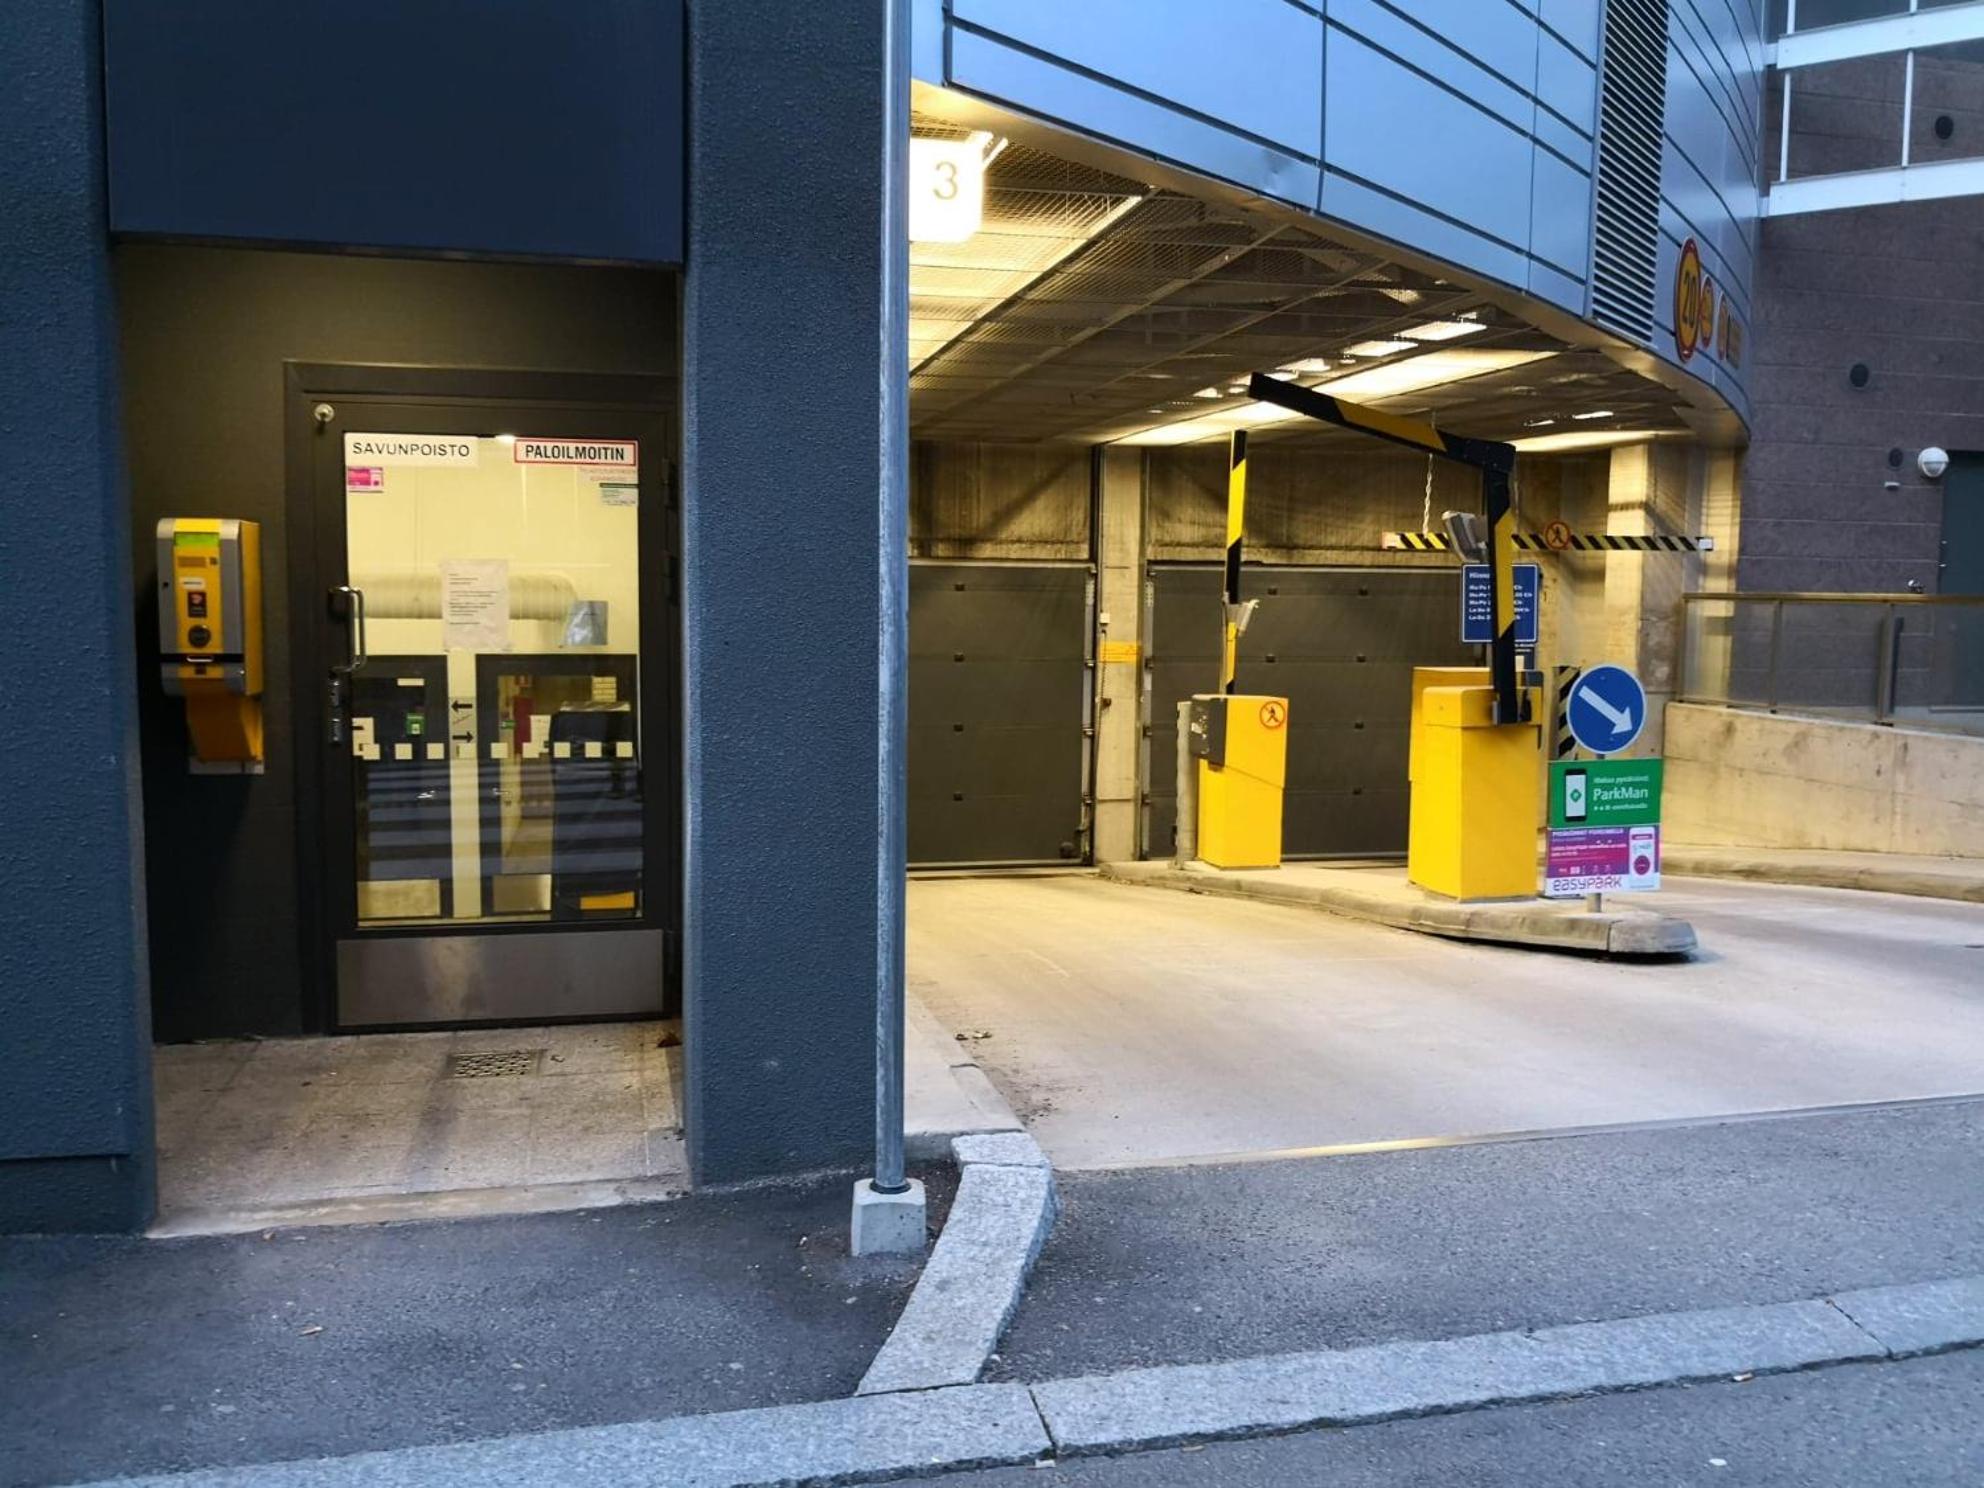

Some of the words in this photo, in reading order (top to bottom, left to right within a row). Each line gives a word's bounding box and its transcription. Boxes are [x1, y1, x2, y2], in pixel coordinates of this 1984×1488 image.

[933, 160, 958, 200] 3
[1681, 270, 1697, 329] 20
[352, 441, 471, 458] SAVUNPOISTO
[525, 444, 625, 461] PALOILMOITIN
[1593, 787, 1649, 801] ParkMan
